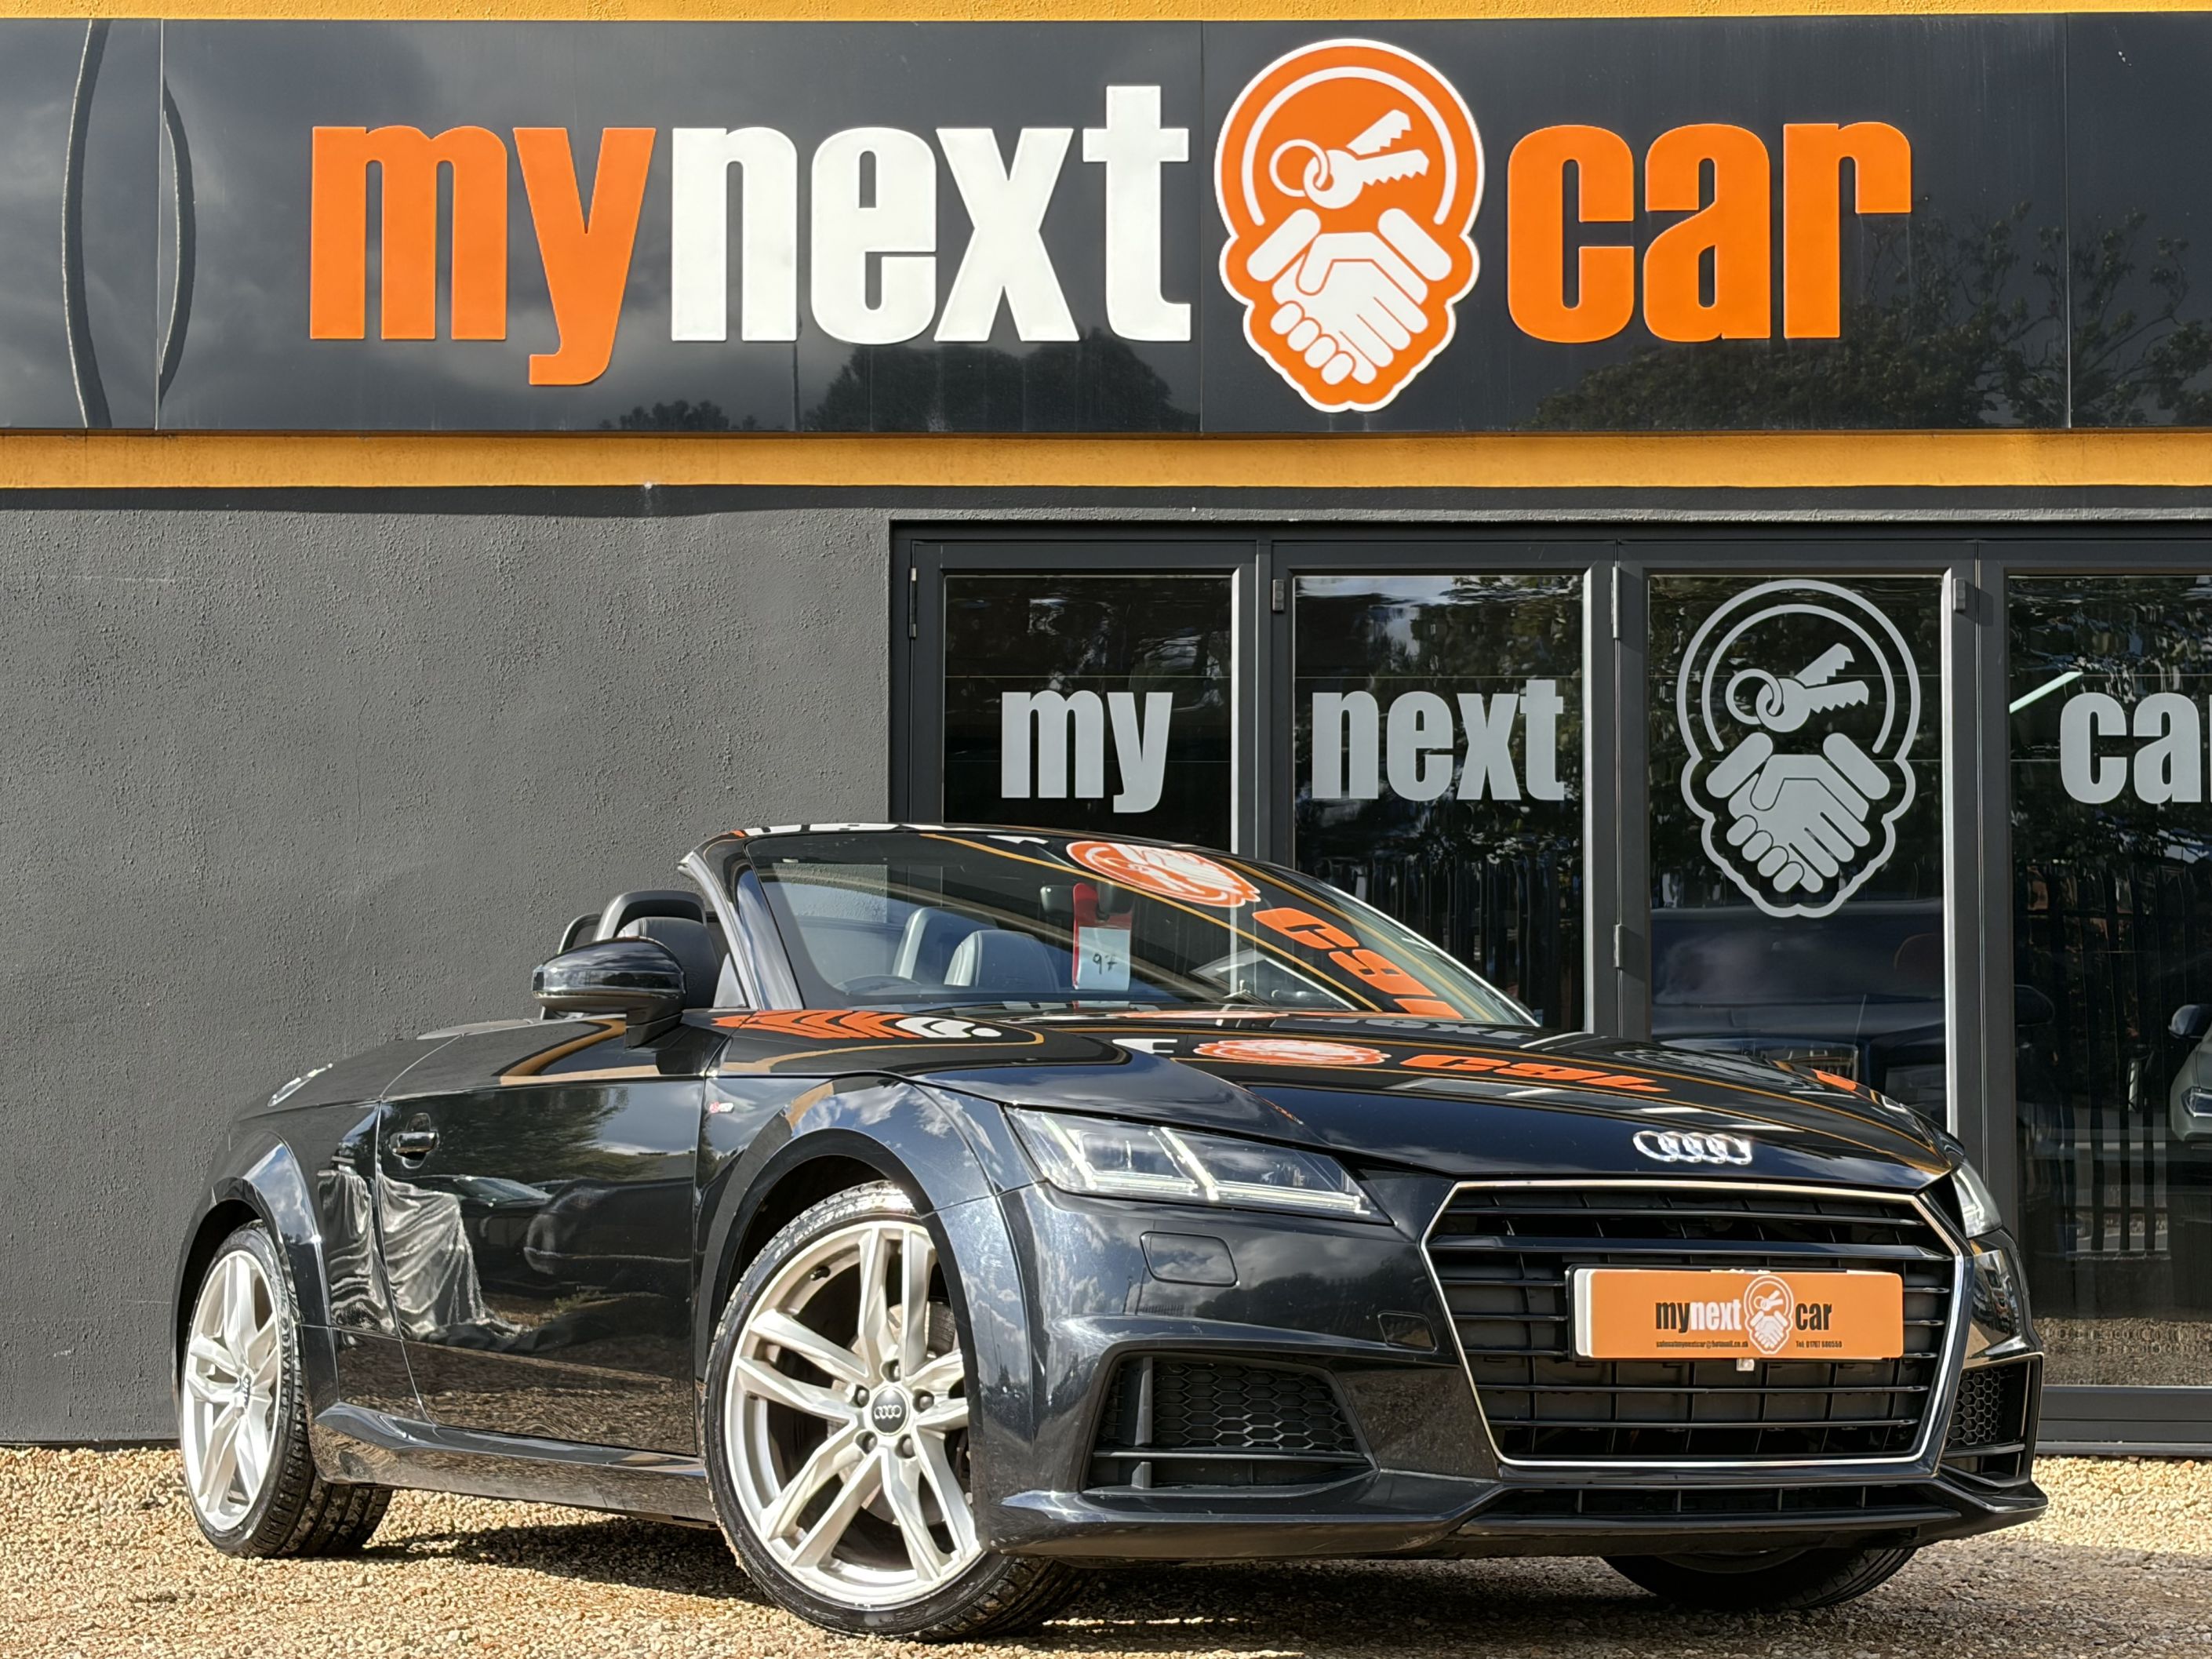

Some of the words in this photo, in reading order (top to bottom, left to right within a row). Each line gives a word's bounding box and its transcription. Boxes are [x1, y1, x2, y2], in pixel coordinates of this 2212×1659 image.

[1507, 122, 1912, 343] car
[1000, 689, 1173, 813] my
[1312, 679, 1565, 801] next
[2060, 692, 2212, 804] ca
[1795, 1301, 1832, 1331] car
